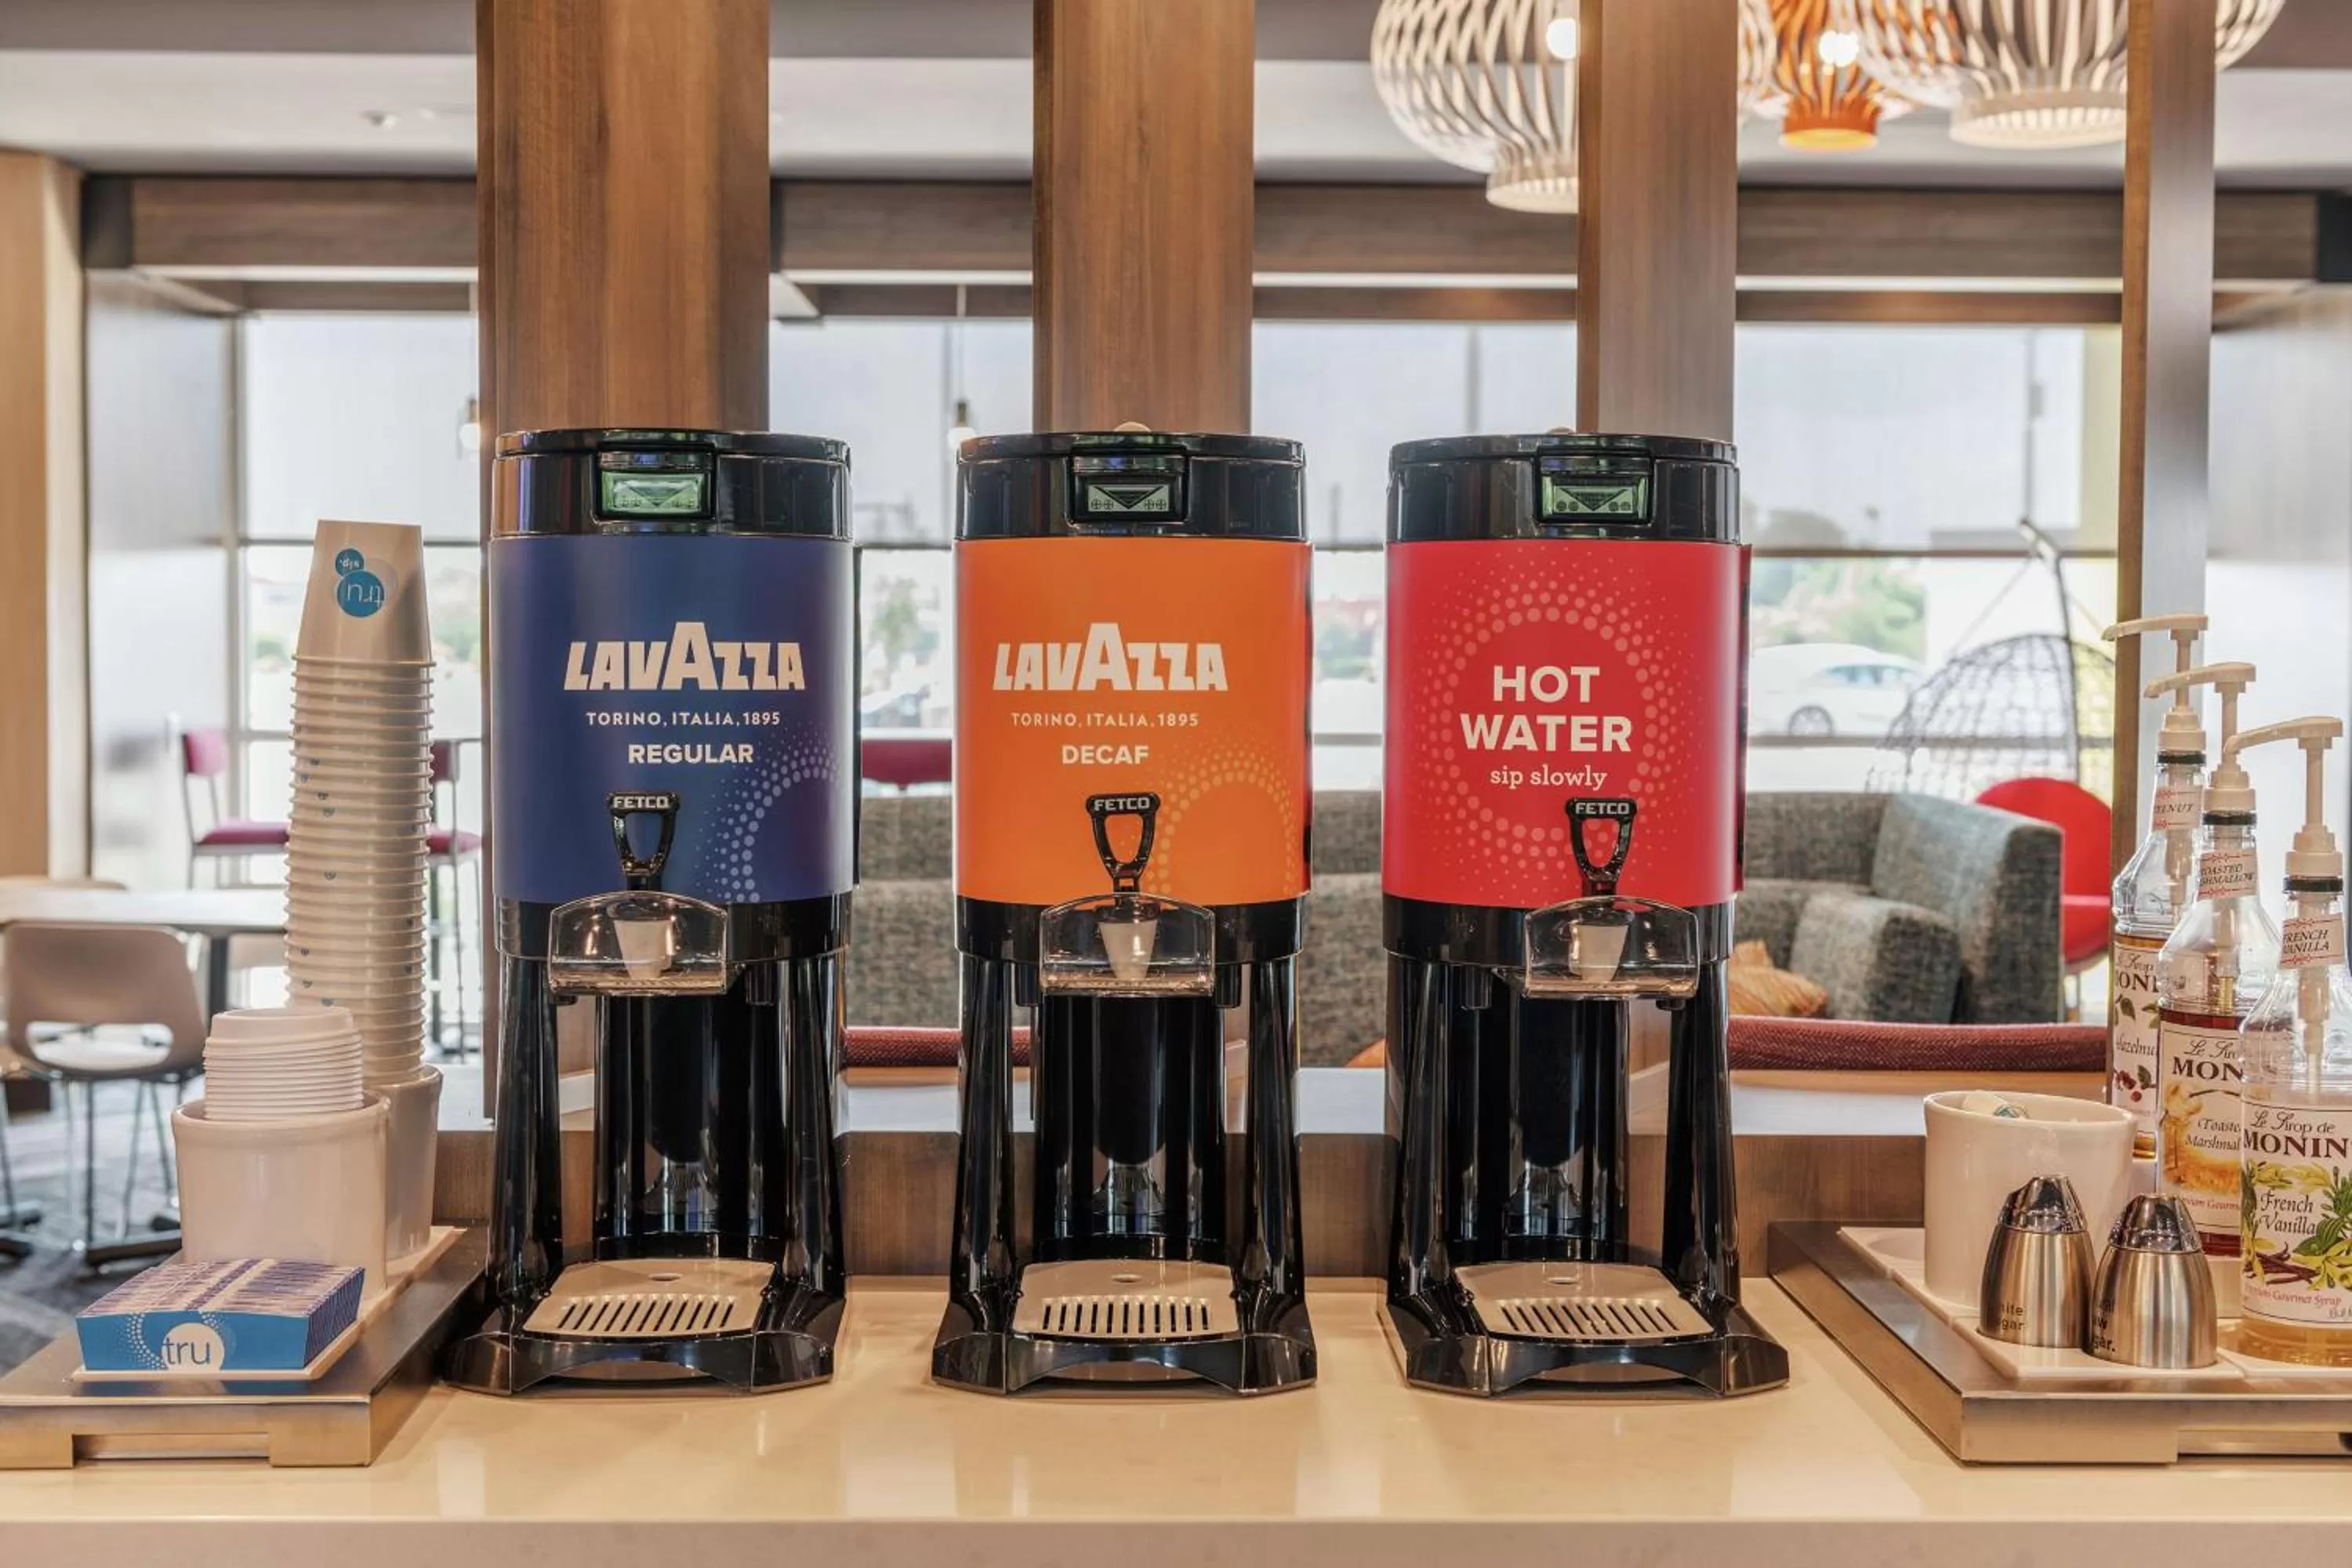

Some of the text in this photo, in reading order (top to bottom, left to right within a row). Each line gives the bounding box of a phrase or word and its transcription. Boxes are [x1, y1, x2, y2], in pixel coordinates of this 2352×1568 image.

[347, 583, 383, 608] tru
[564, 622, 805, 691] LAVAZZA
[993, 622, 1229, 691] LAVAZZA
[1494, 666, 1600, 703] HOT
[586, 712, 667, 727] TORINO,
[742, 712, 780, 725] 1895
[1157, 713, 1199, 727] 1895
[1460, 714, 1632, 752] WATER
[628, 744, 753, 764] REGULAR
[1062, 745, 1149, 764] DECAF
[1490, 764, 1608, 791] sip slowly
[613, 796, 670, 809] FETCO
[1094, 797, 1150, 811] FETCO
[1575, 802, 1630, 815] FETCO
[2115, 971, 2159, 993] ONI
[2183, 1039, 2236, 1059] Le Sir
[2172, 1056, 2243, 1081] MON
[2198, 1118, 2241, 1133] Toaste
[2250, 1109, 2336, 1138] Le Sirop de
[2185, 1134, 2241, 1150] Marshmal
[2244, 1129, 2349, 1159] MONIN
[2260, 1189, 2314, 1213] French
[2259, 1211, 2316, 1235] Vanilla
[2001, 1301, 2024, 1316] ite
[1998, 1318, 2025, 1331] gar
[165, 1338, 211, 1365] tru
